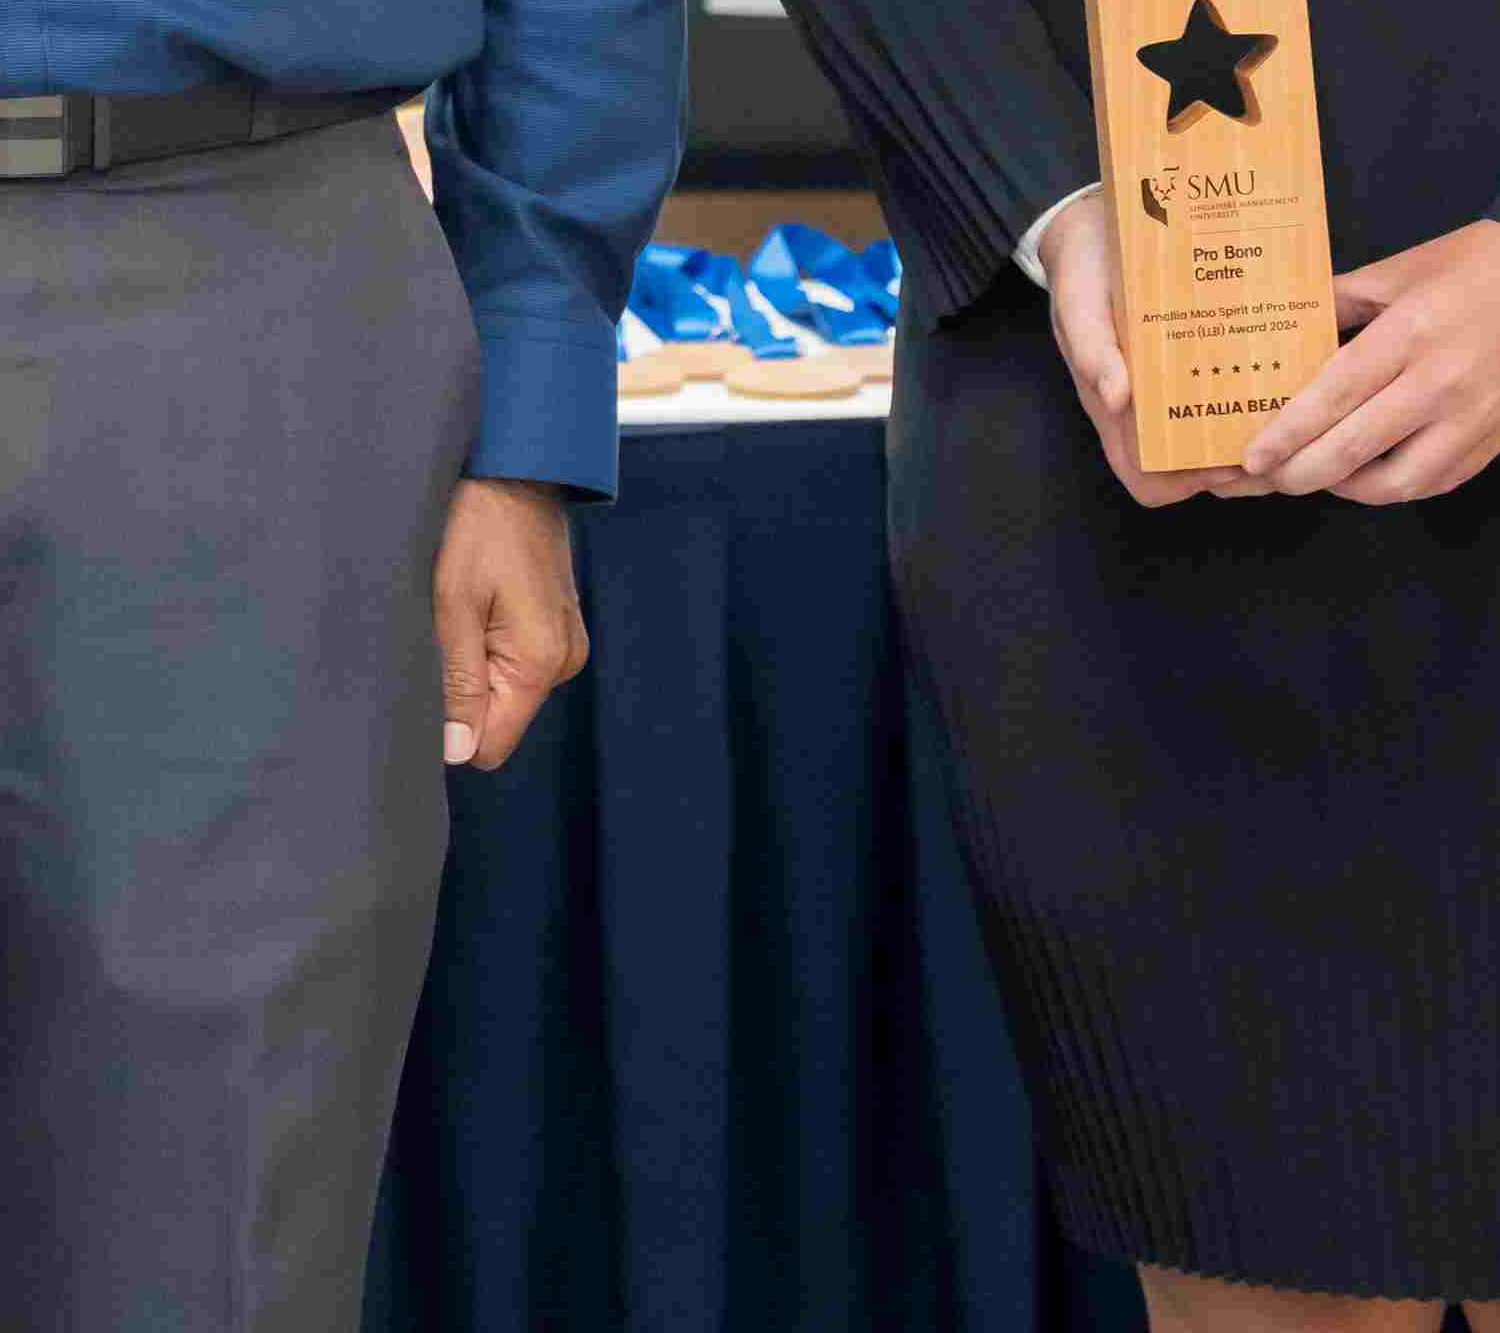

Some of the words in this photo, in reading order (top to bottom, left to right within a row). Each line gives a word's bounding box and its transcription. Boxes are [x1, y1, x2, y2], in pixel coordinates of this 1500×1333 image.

[1187, 170, 1255, 200] SMU
[1193, 247, 1218, 262] Pro
[1224, 245, 1263, 260] Bono
[1195, 265, 1244, 282] Centre
[1251, 302, 1264, 314] of
[1266, 302, 1285, 313] Pro
[1228, 322, 1266, 334] Award
[1269, 319, 1298, 332] 2024
[1168, 400, 1243, 420] NATALIA
